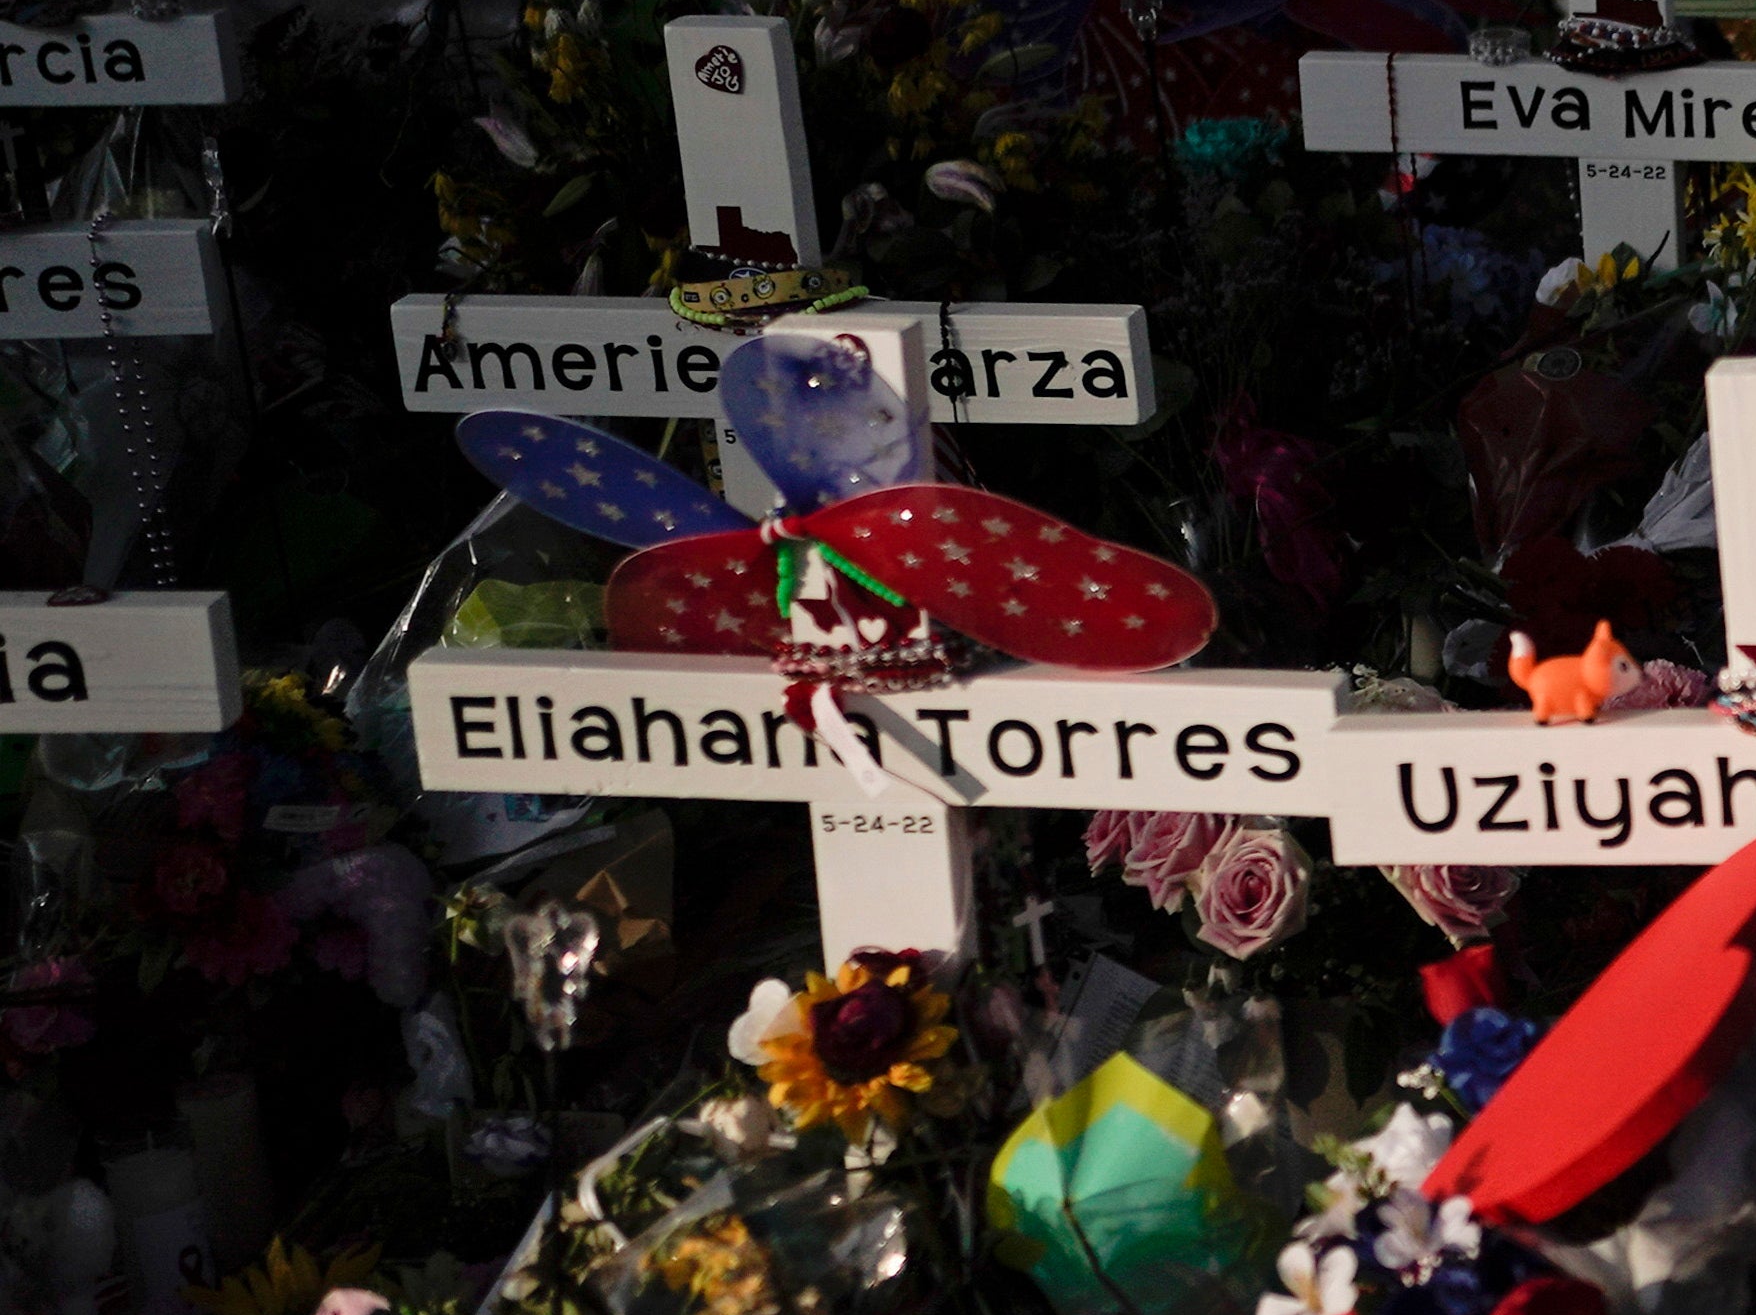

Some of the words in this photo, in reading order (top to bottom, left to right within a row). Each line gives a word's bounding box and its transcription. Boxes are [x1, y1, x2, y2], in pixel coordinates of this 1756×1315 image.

[1460, 80, 1590, 131] Eva
[1586, 163, 1666, 181] 5-24-22
[413, 334, 721, 393] Amerie
[930, 347, 1129, 400] arza
[448, 695, 883, 769] Eliahana
[916, 708, 1301, 781] Torres
[821, 814, 932, 834] 5-24-22
